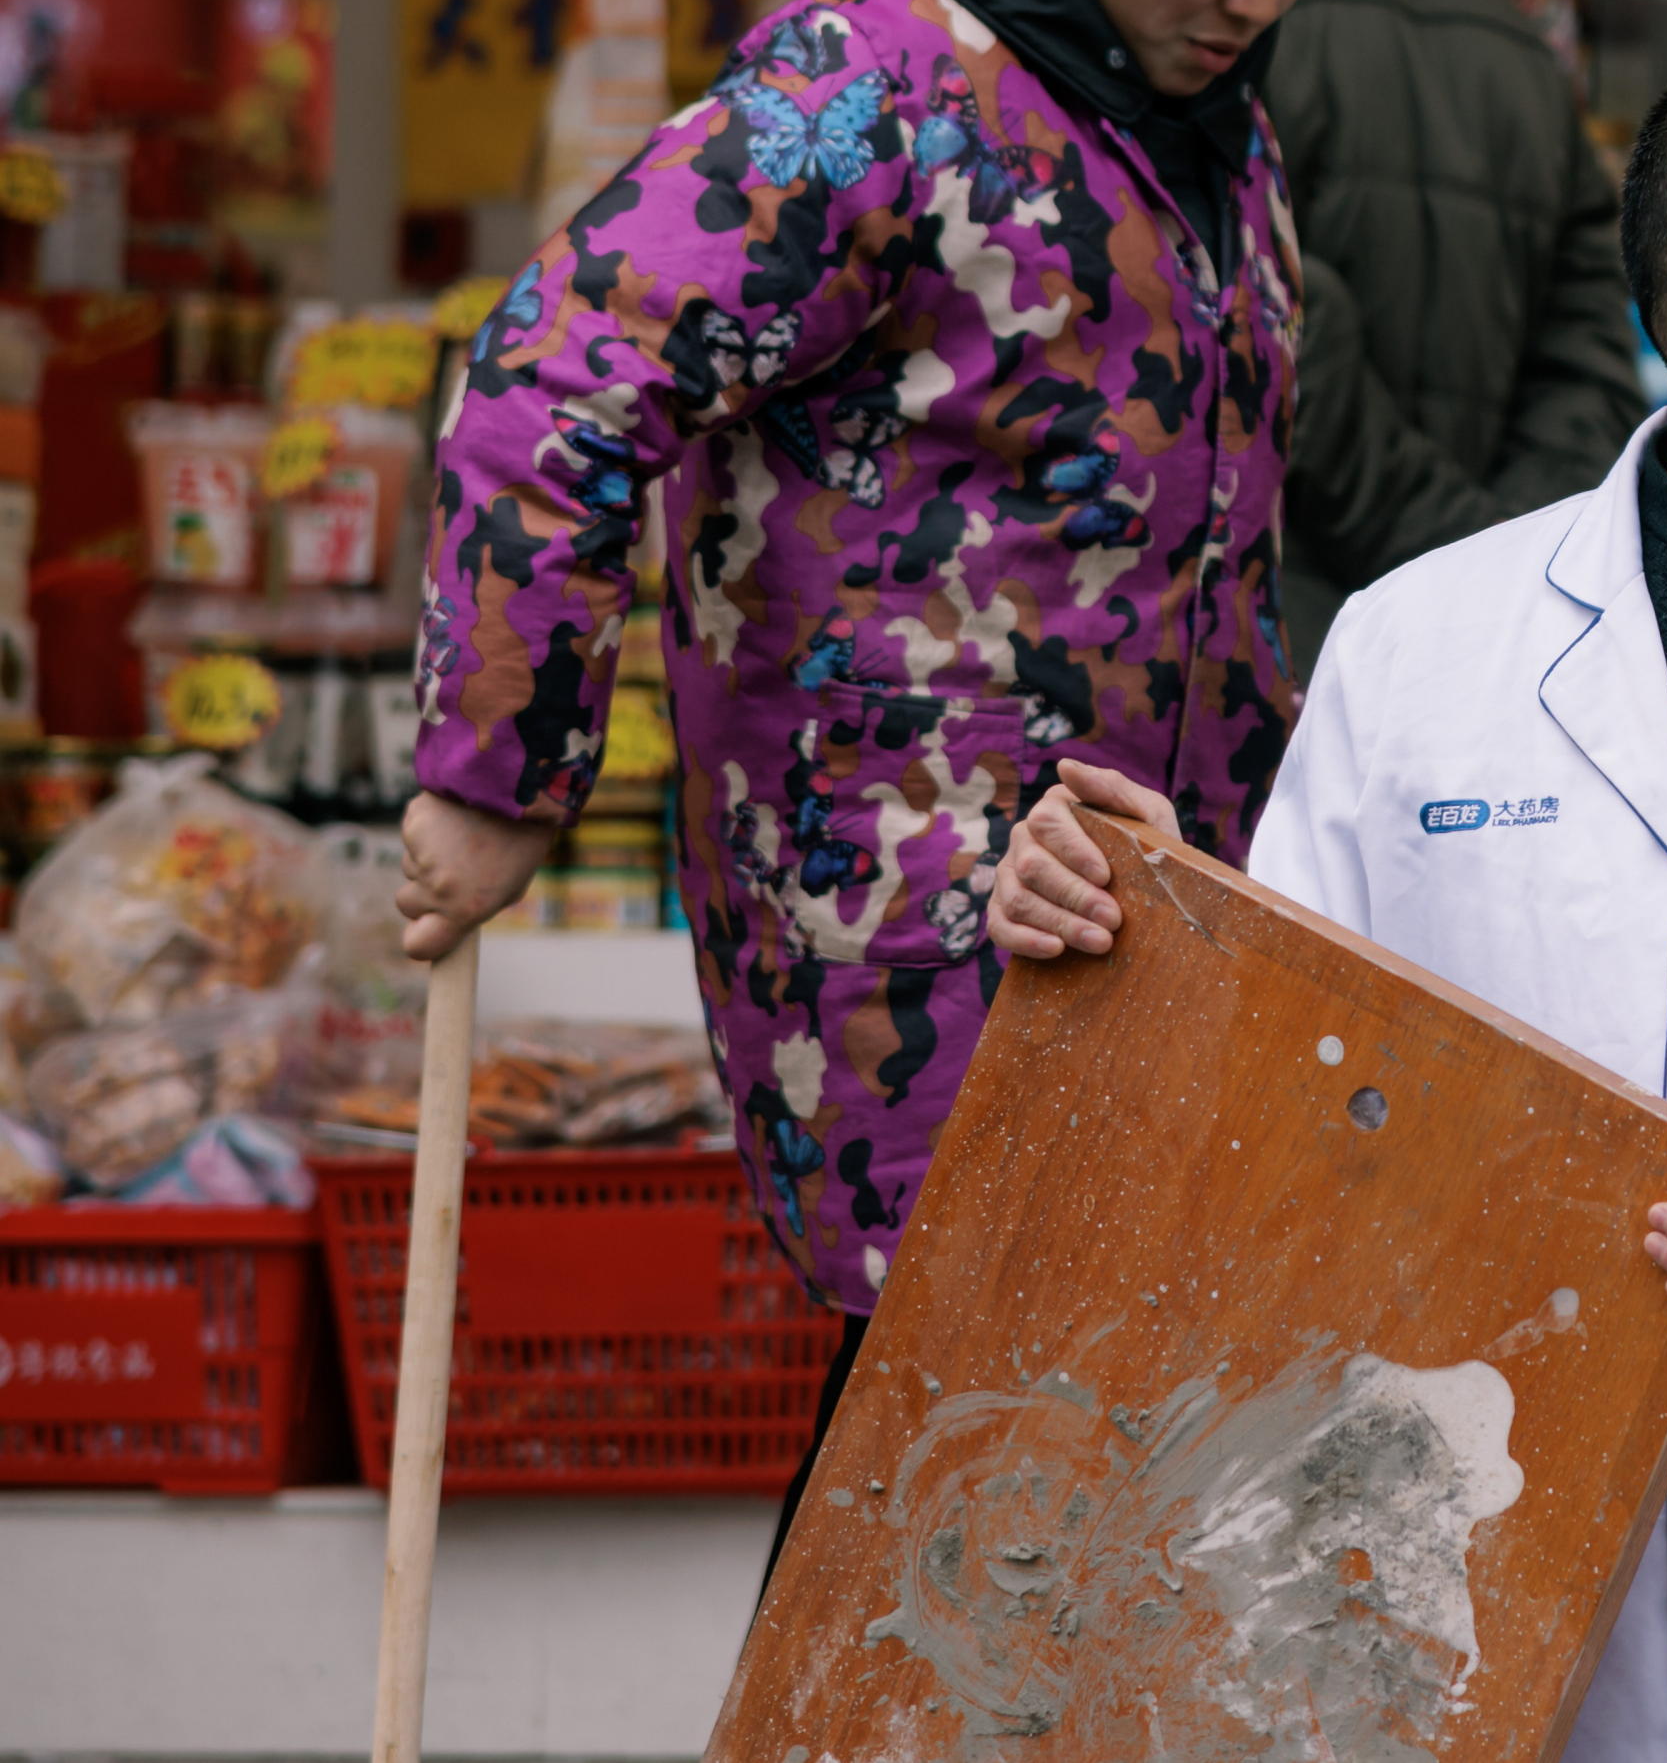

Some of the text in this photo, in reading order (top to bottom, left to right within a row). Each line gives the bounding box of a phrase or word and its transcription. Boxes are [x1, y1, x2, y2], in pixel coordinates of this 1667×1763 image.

[1426, 795, 1560, 828] 老百姓 大药房
[1512, 814, 1559, 828] PHARMACY
